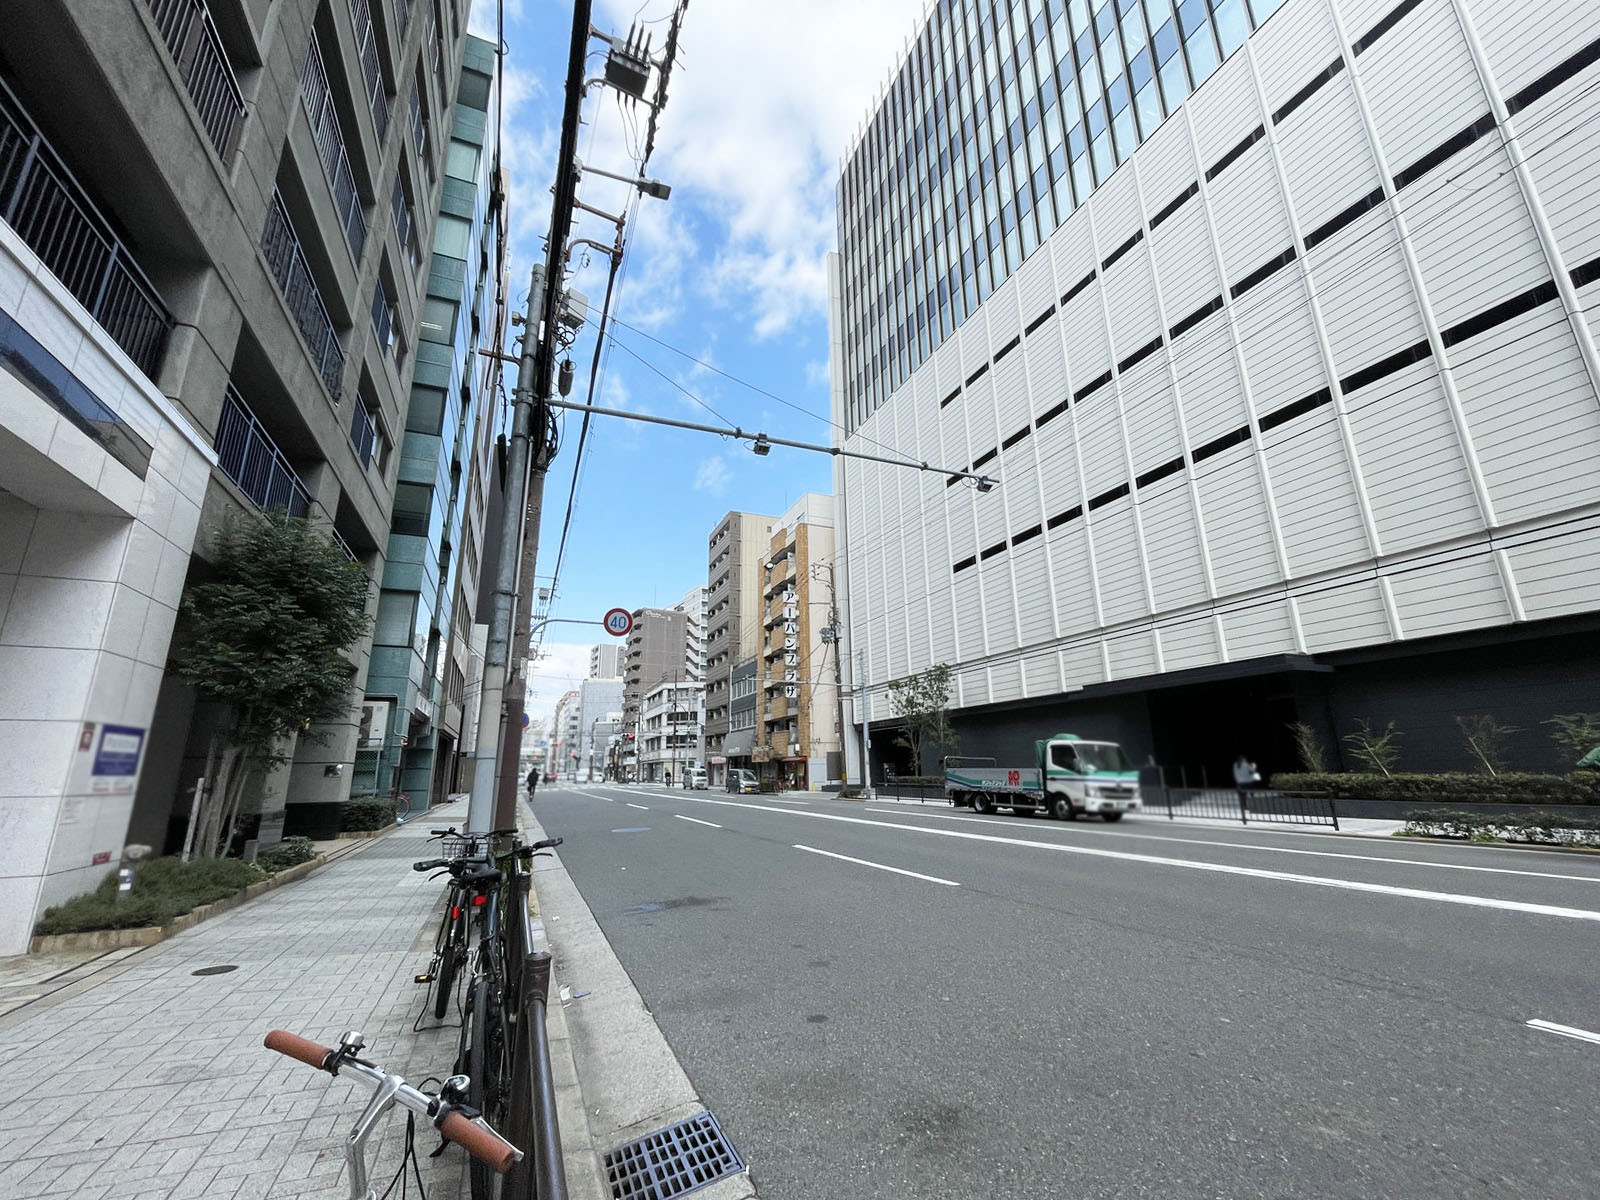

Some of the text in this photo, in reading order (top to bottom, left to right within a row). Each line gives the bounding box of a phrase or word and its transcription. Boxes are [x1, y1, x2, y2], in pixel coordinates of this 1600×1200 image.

[610, 615, 626, 629] 40
[784, 592, 796, 697] アーバンプラザ
